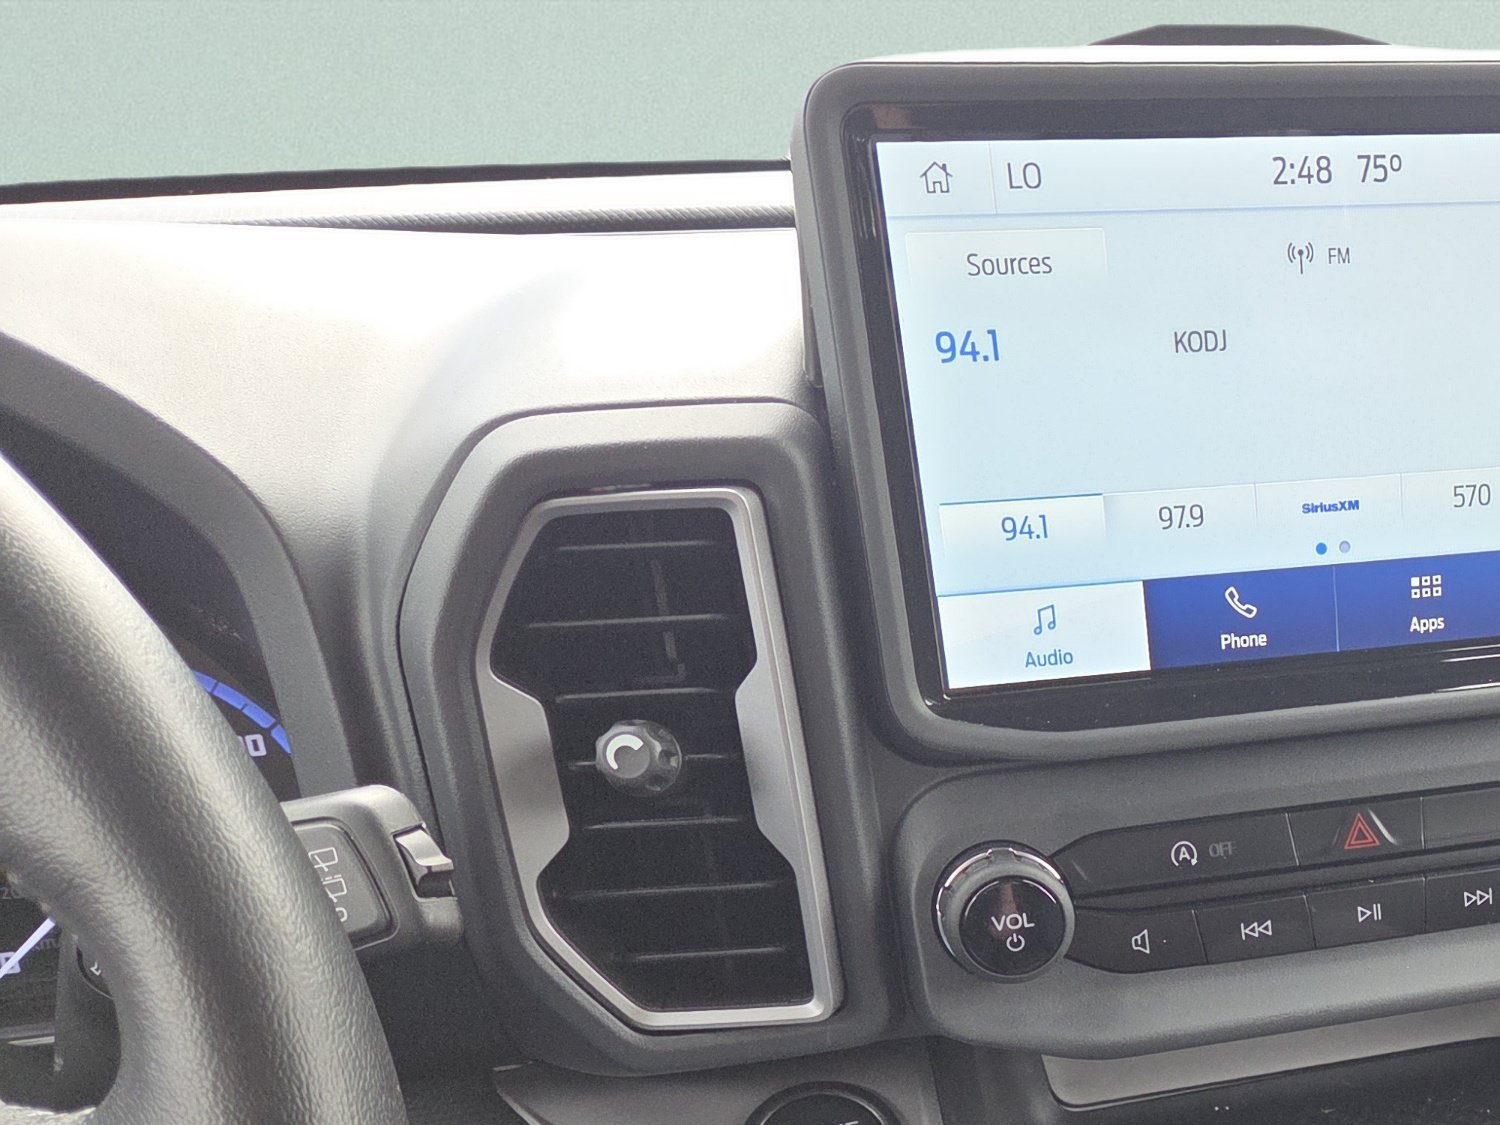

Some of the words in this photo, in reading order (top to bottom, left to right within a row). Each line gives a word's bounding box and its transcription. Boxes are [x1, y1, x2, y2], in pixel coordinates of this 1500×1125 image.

[1007, 162, 1042, 190] LO
[1271, 155, 1333, 186] 2:48
[966, 252, 1053, 277] Sources
[1328, 247, 1351, 265] FM
[934, 328, 1000, 364] 94.1
[1173, 329, 1228, 354] KODJ
[1302, 498, 1360, 514] SiriusXM
[1452, 483, 1492, 509] 570
[1000, 514, 1049, 542] 94.1
[1157, 503, 1205, 531] 97.9
[1409, 615, 1446, 634] Apps
[1220, 631, 1268, 651] Phone
[1024, 648, 1074, 669] Audio
[990, 911, 1036, 933] VOL
